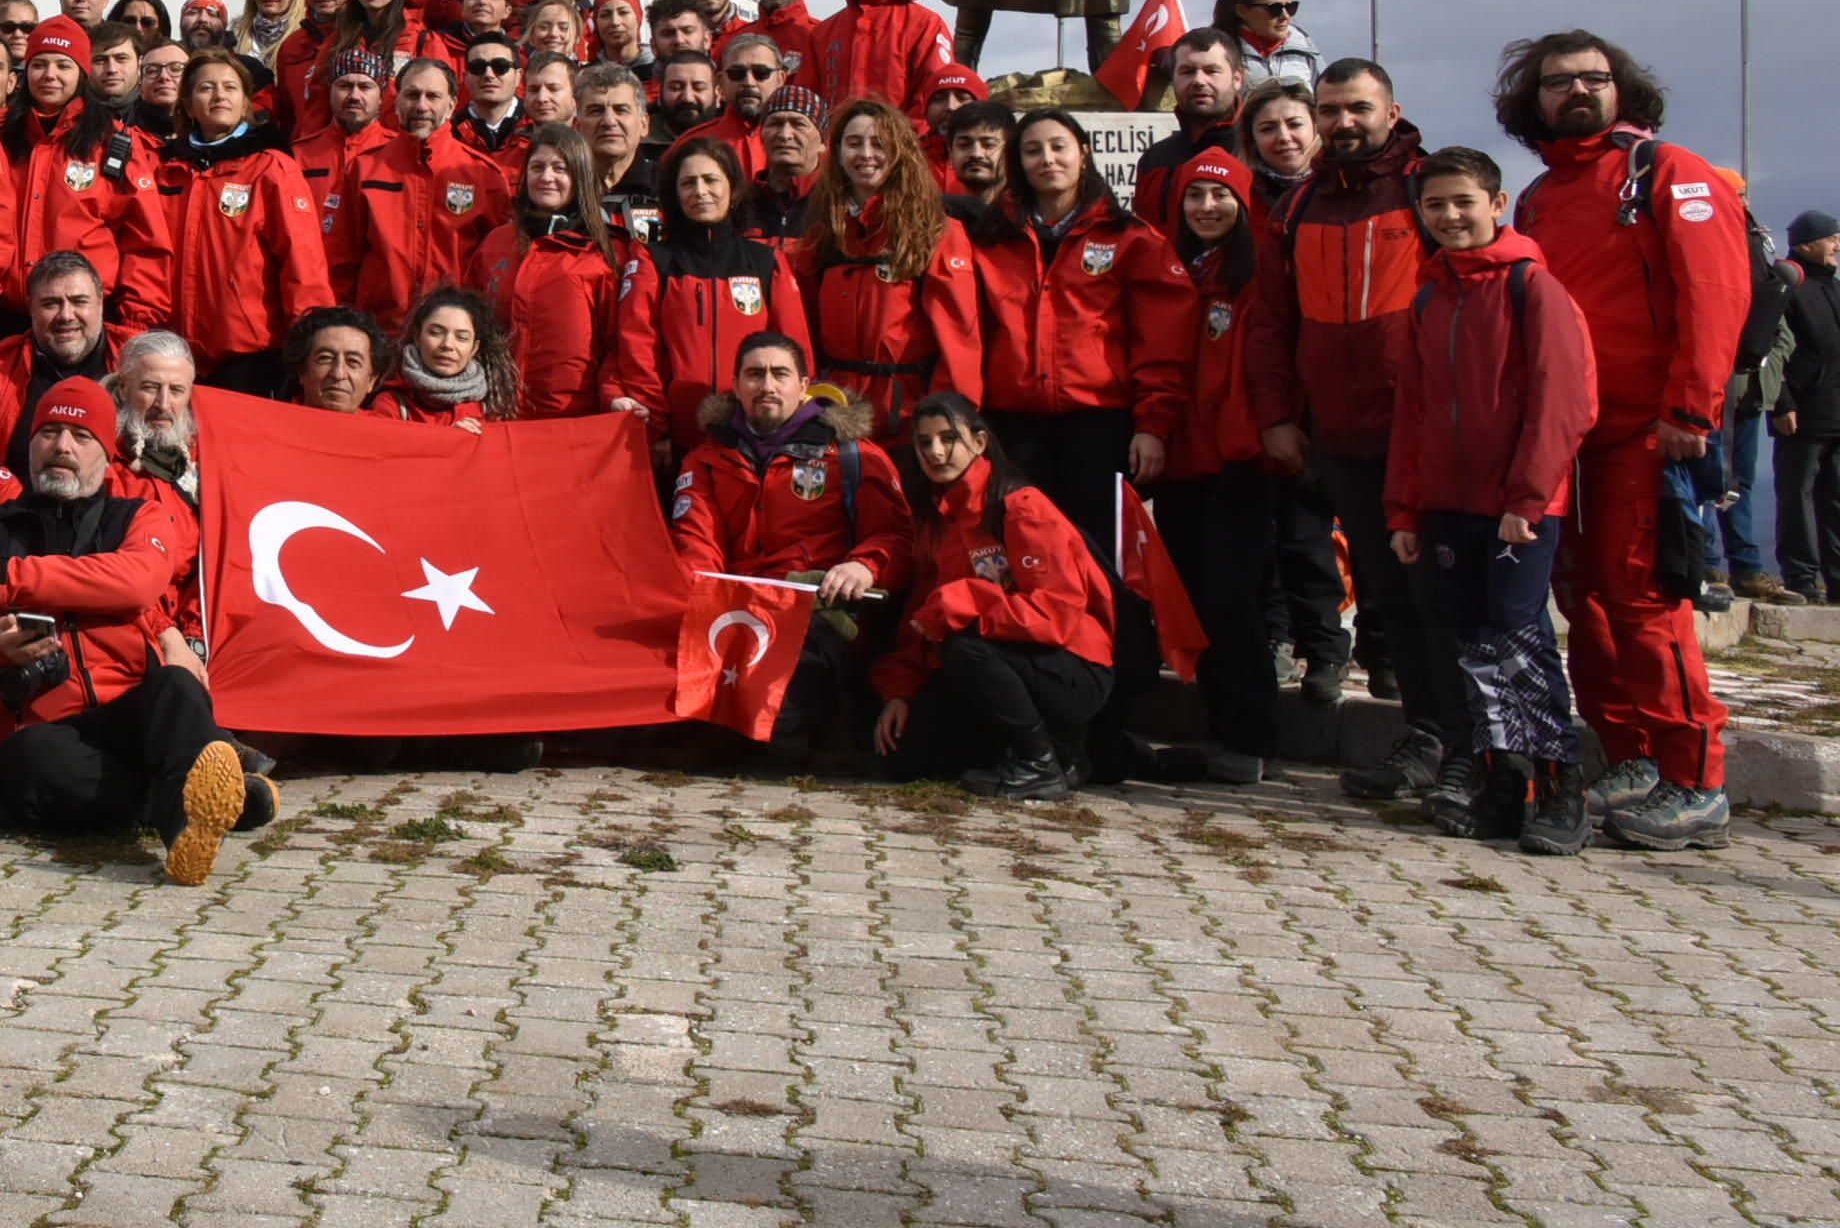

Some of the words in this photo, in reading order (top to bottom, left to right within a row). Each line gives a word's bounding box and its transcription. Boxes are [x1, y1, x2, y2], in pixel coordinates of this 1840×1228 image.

[42, 37, 71, 48] AKUT
[938, 75, 967, 85] AKUT
[1196, 164, 1230, 177] AKUT
[632, 209, 658, 217] AKUT
[731, 277, 759, 285] AKUT
[49, 405, 87, 419] AKUT
[972, 546, 1002, 557] AKUT
